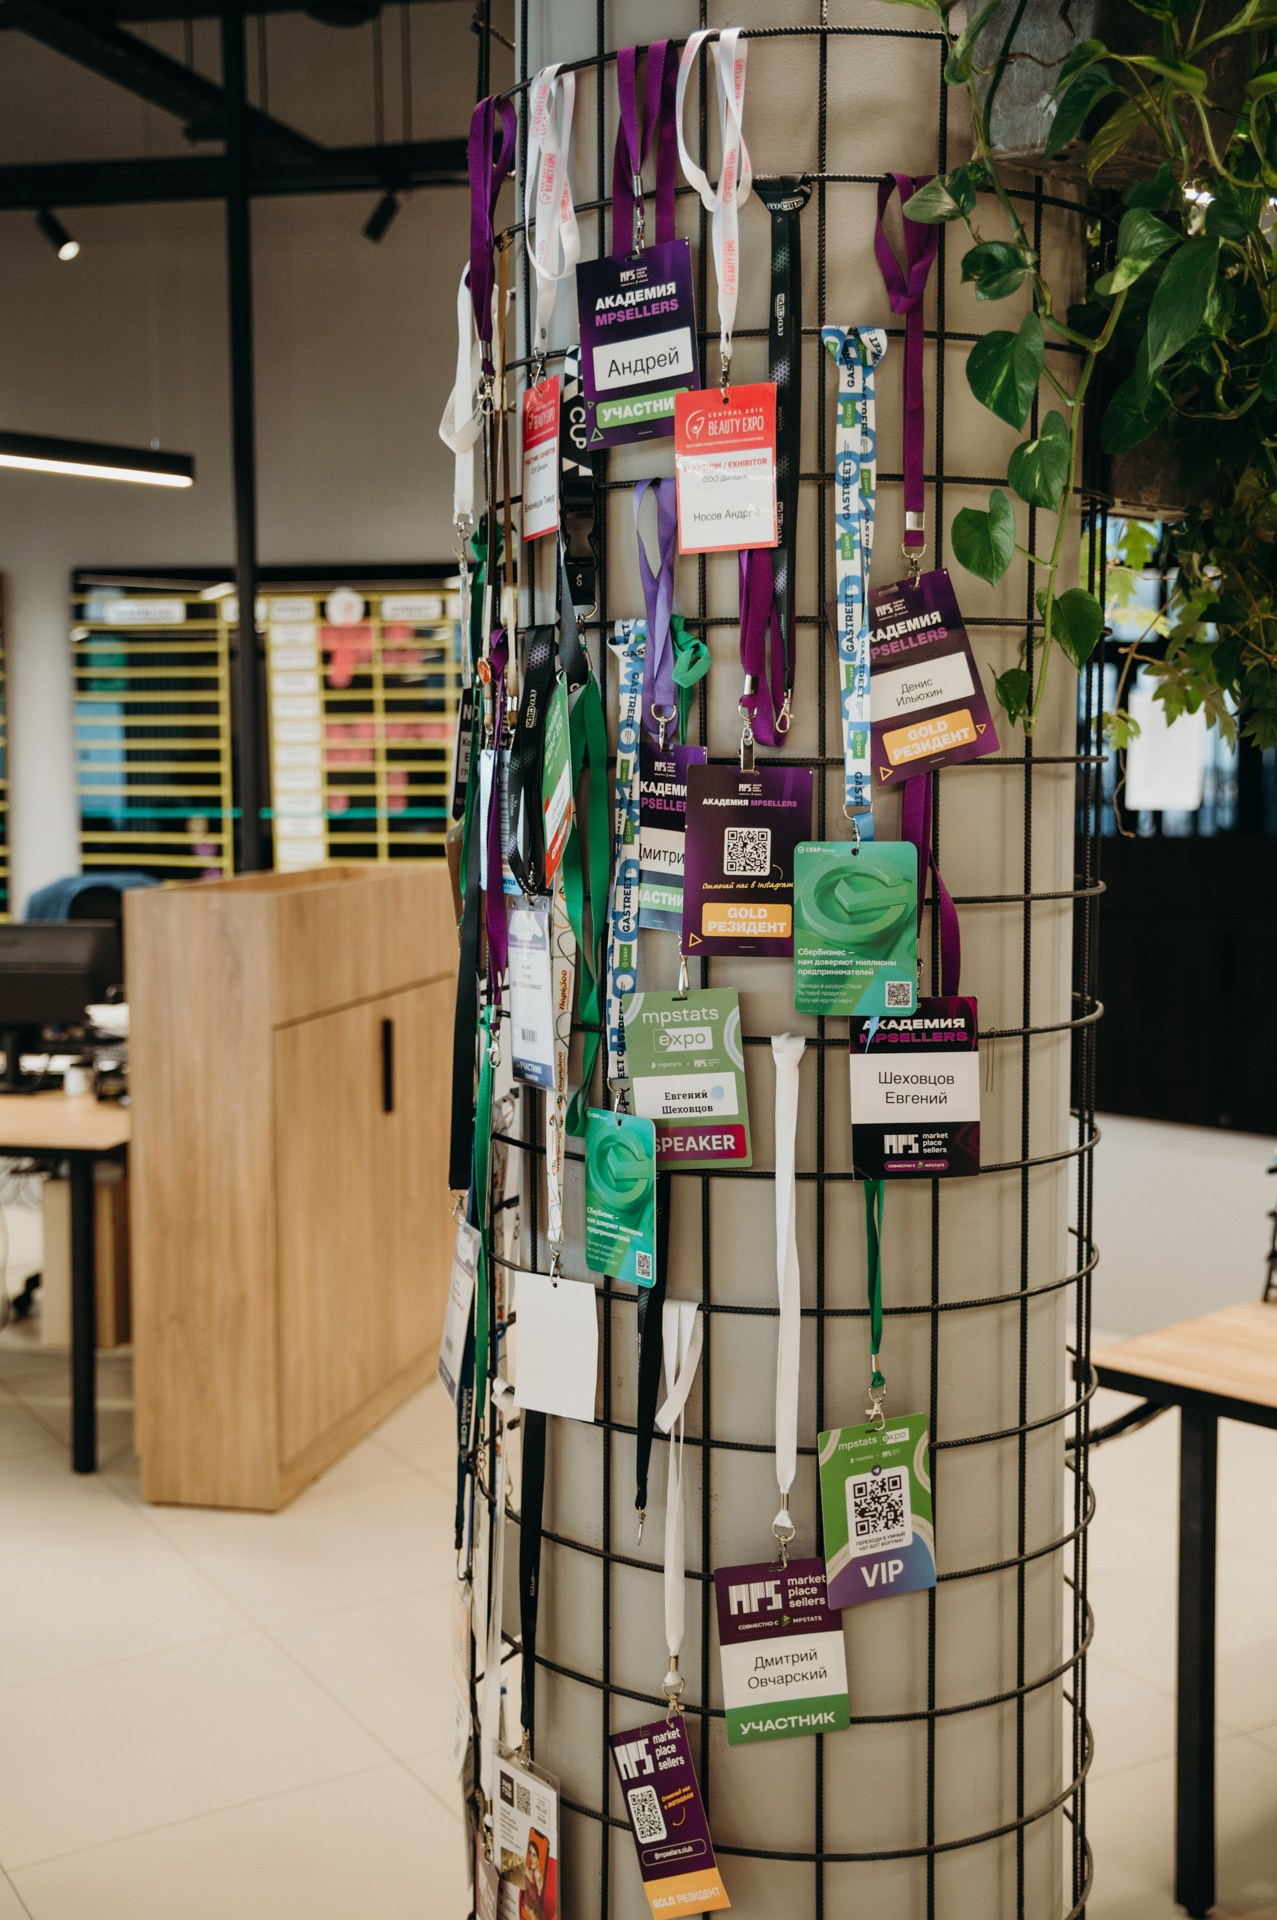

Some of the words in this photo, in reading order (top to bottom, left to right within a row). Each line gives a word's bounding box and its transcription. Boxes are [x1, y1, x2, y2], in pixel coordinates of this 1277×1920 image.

[595, 282, 677, 311] АКАДЕМИЯ
[595, 299, 679, 327] MPSELLERS
[607, 346, 680, 378] Андрей
[708, 409, 742, 418] CENTRAL
[745, 407, 763, 415] ASIA
[708, 418, 740, 436] BEAUTY
[742, 415, 764, 432] EXPO
[728, 457, 768, 469] EXHIBITOR
[842, 462, 852, 521] GASTREET
[693, 511, 722, 523] Носов
[845, 593, 854, 652] GASTREET
[869, 627, 949, 661] PSELLERS
[900, 677, 933, 695] Денис
[626, 671, 639, 729] GASTREET
[895, 688, 943, 707] Ильюхин
[908, 720, 949, 742] GOLD
[892, 727, 971, 761] РЕЗИДЕНТ
[702, 798, 749, 807] АКАДЕМИЯ
[750, 799, 798, 808] MPSELLERS
[622, 876, 632, 933] GASTREET
[727, 907, 768, 919] GOLD
[707, 921, 787, 935] РЕЗИДЕНТ
[797, 948, 846, 958] СберБизнес
[797, 967, 874, 977] предпринимателей
[814, 958, 854, 968] доверяют
[855, 959, 897, 967] миллионы
[642, 1007, 719, 1027] mpstats
[659, 1032, 706, 1049] expo
[878, 1071, 955, 1086] Шеховцов
[664, 1089, 708, 1101] Евгений
[885, 1091, 948, 1105] Евгений
[661, 1105, 714, 1115] Шеховцов
[923, 1139, 943, 1148] place
[838, 1435, 878, 1451] mpstats
[882, 1431, 906, 1443] expo
[787, 1574, 827, 1586] market
[860, 1559, 904, 1588] VIP
[788, 1586, 818, 1599] place
[789, 1597, 826, 1608] sellers
[738, 1621, 773, 1631] СОВМЕСТНО
[792, 1615, 823, 1624] MPSTATS
[753, 1648, 818, 1672] Дмитрий
[747, 1666, 828, 1690] Овчарский
[739, 1711, 836, 1735] УЧАСТНИК
[652, 1727, 682, 1745] market
[654, 1743, 677, 1761] place
[658, 1755, 685, 1771] sellers
[652, 1895, 676, 1909] GOLD
[676, 1886, 721, 1904] РЕЗИДЕНТ
